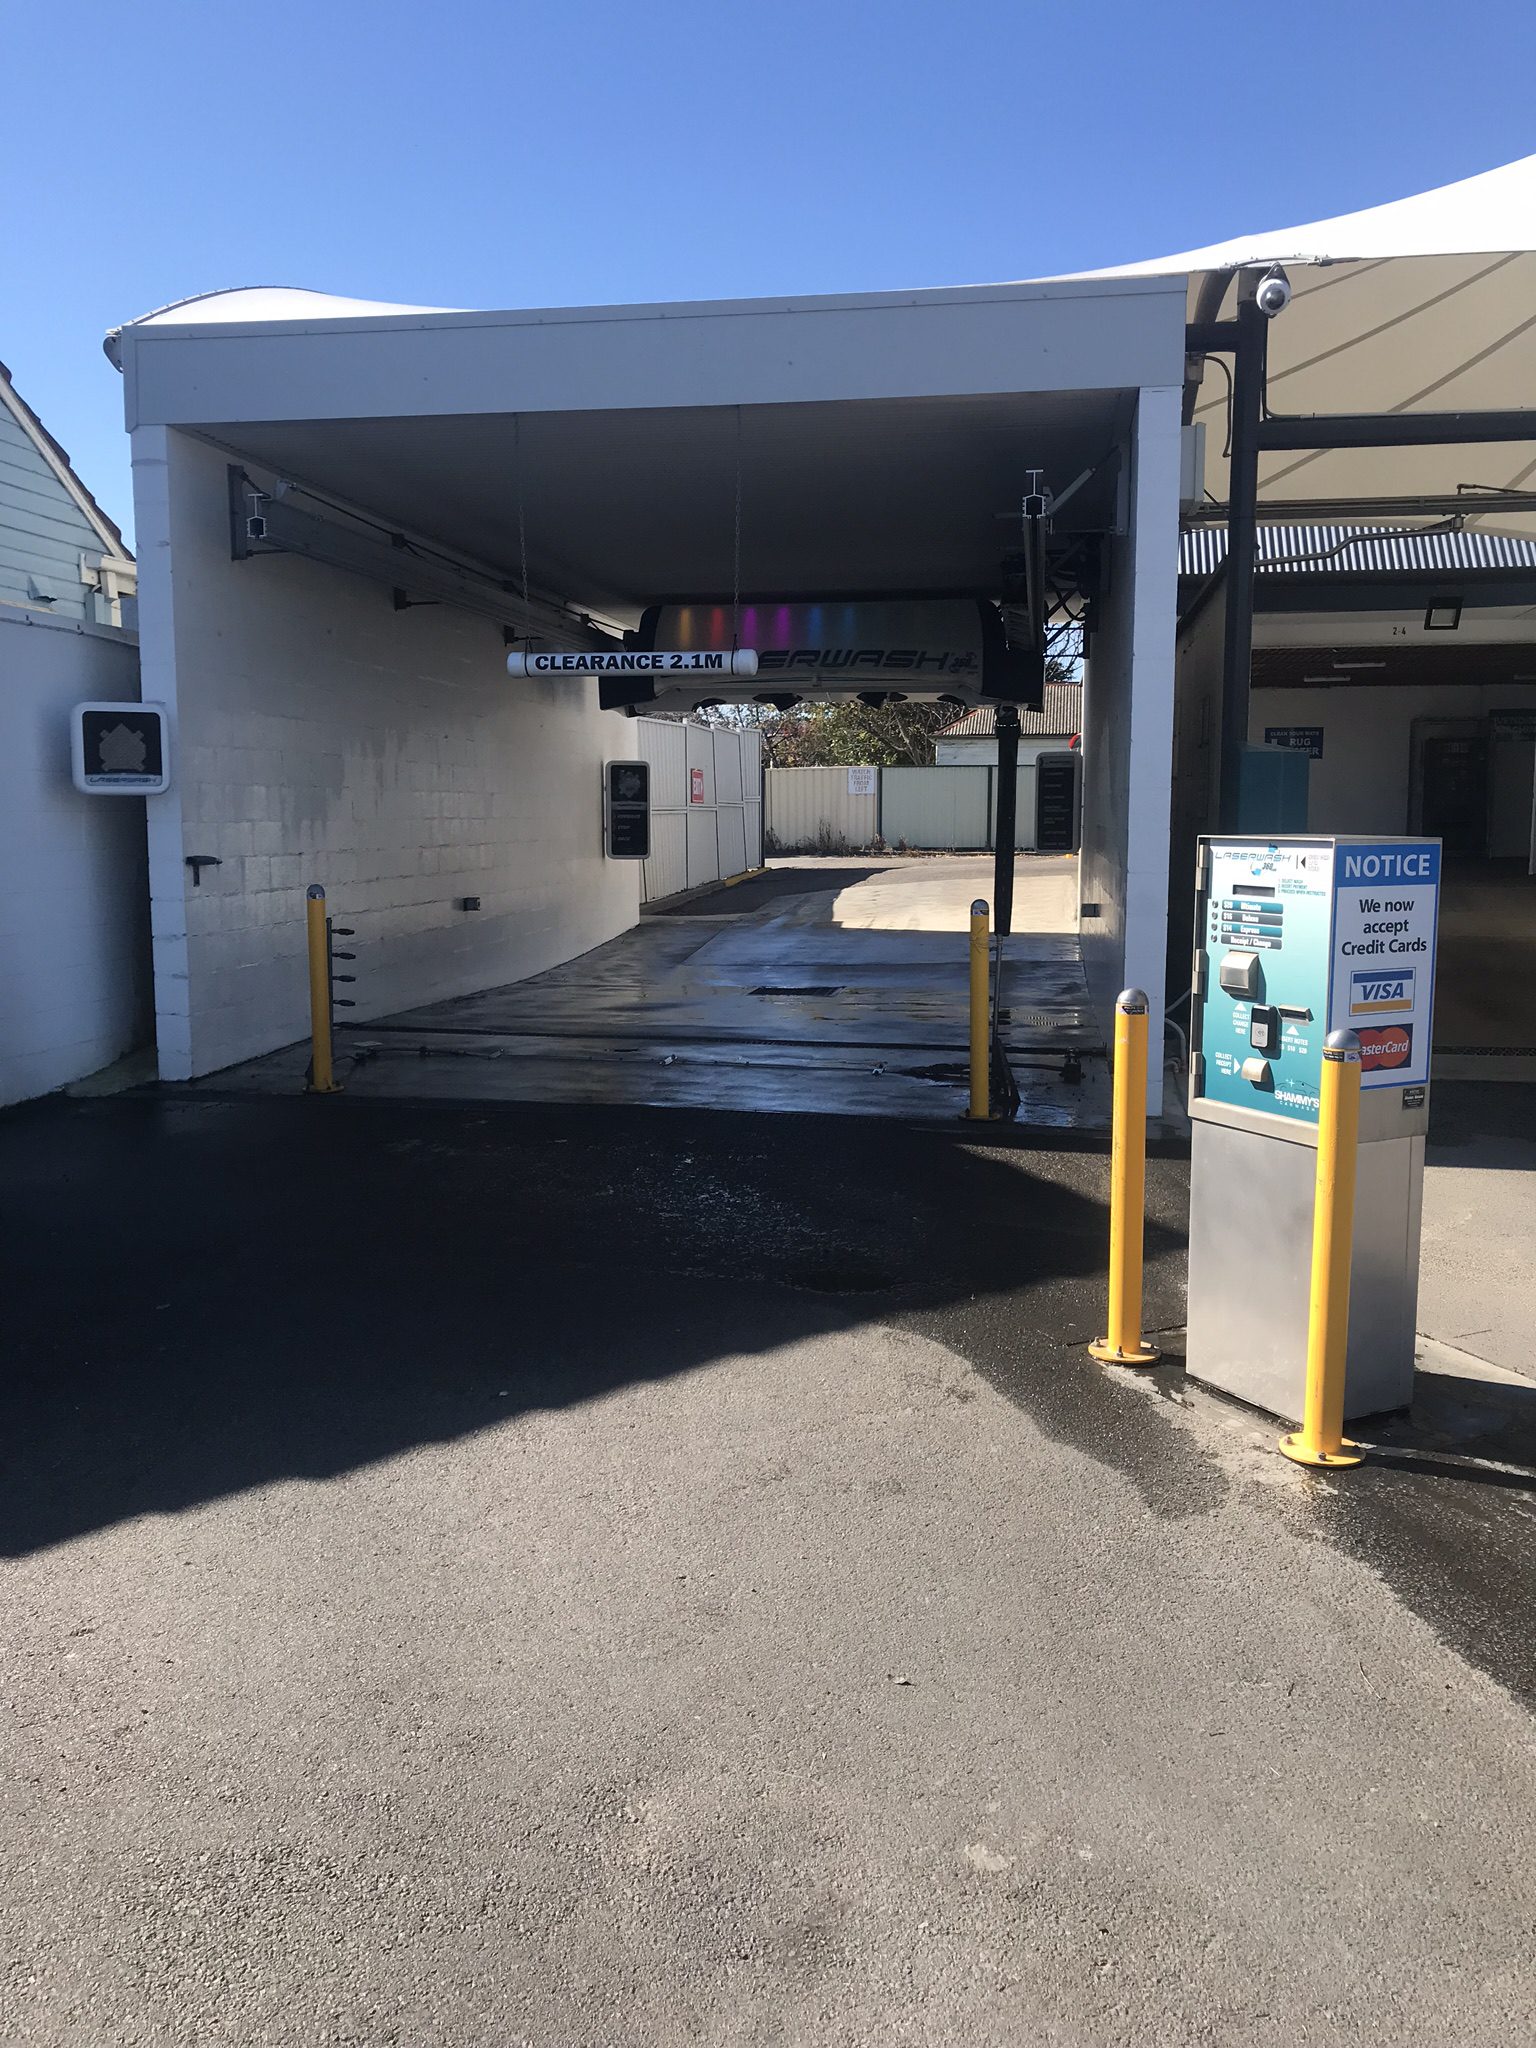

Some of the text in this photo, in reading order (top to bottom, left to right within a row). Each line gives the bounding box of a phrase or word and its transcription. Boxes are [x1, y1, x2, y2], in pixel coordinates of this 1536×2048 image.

[535, 654, 723, 671] CLEARANCE 2.1M
[758, 650, 950, 671] ERWASH
[1289, 737, 1311, 746] RUG
[1215, 852, 1291, 863] LASERWASH
[1345, 854, 1431, 878] NOTICE
[1359, 899, 1415, 913] We now
[1363, 920, 1409, 936] accept
[1230, 936, 1249, 947] Receipt
[1253, 938, 1272, 949] Change
[1341, 937, 1427, 956] Credit Cards
[1361, 982, 1404, 1000] VISA
[1361, 1039, 1409, 1056] asterCard
[1274, 1089, 1320, 1109] SHAMMY'S
